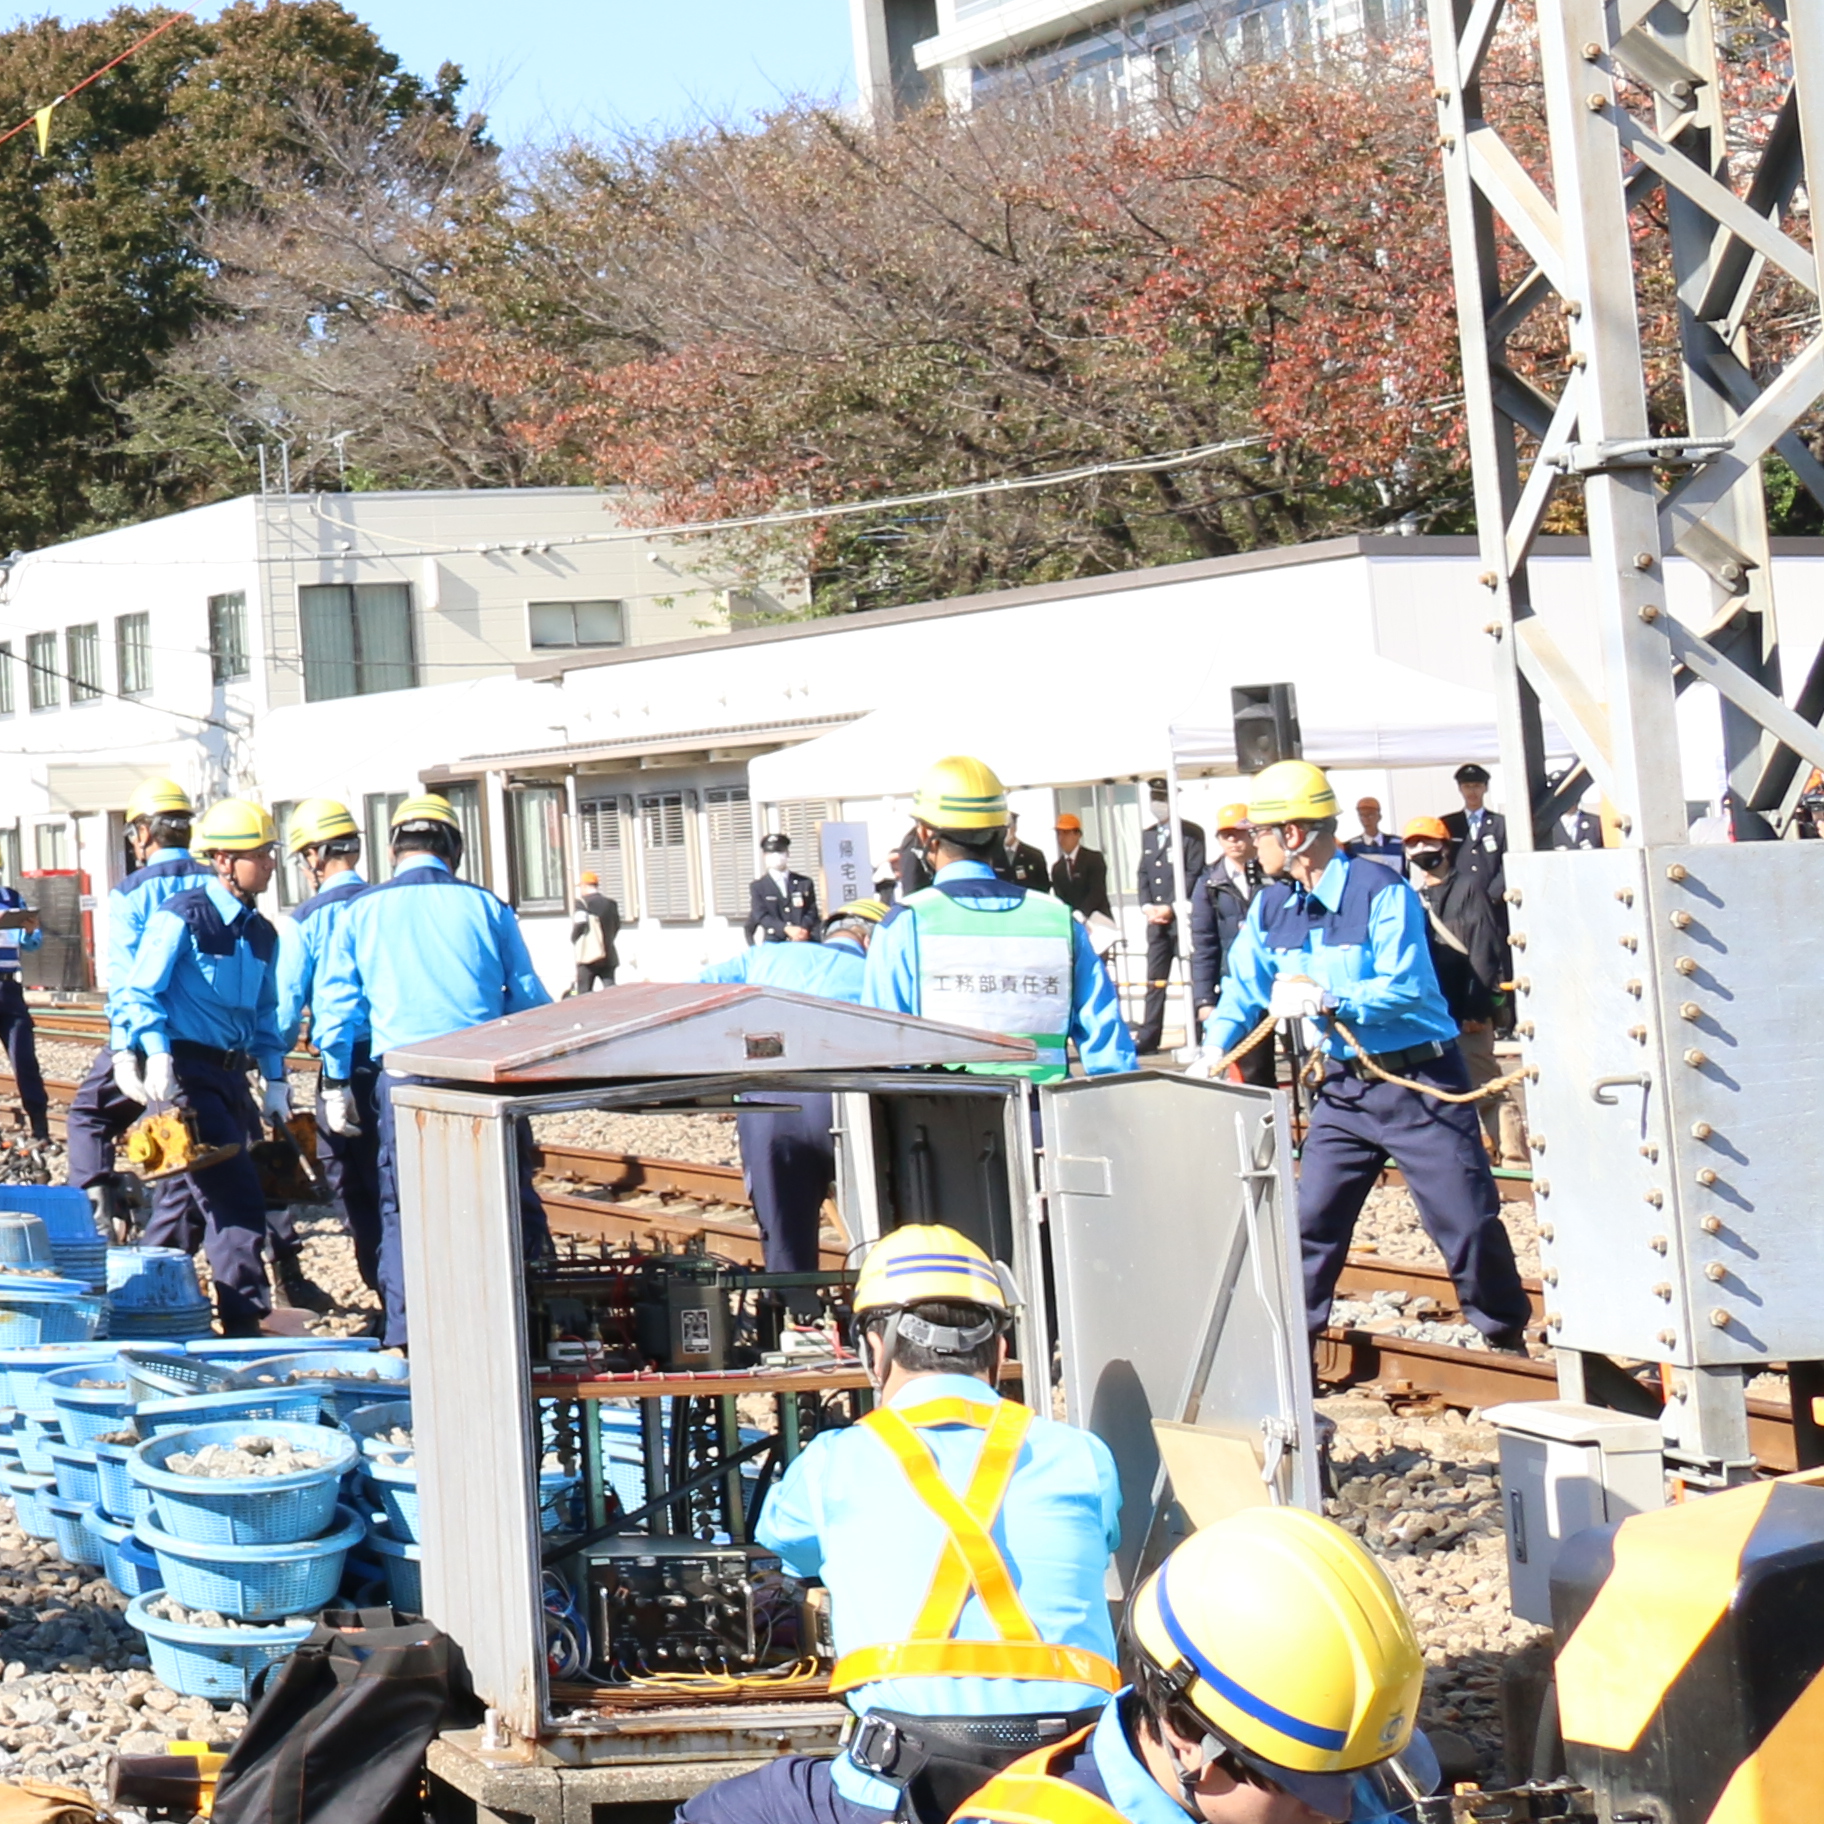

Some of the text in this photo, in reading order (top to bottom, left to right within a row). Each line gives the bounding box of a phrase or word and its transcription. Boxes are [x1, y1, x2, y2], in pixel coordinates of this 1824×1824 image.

[932, 973, 1061, 995] 工務部責任者
